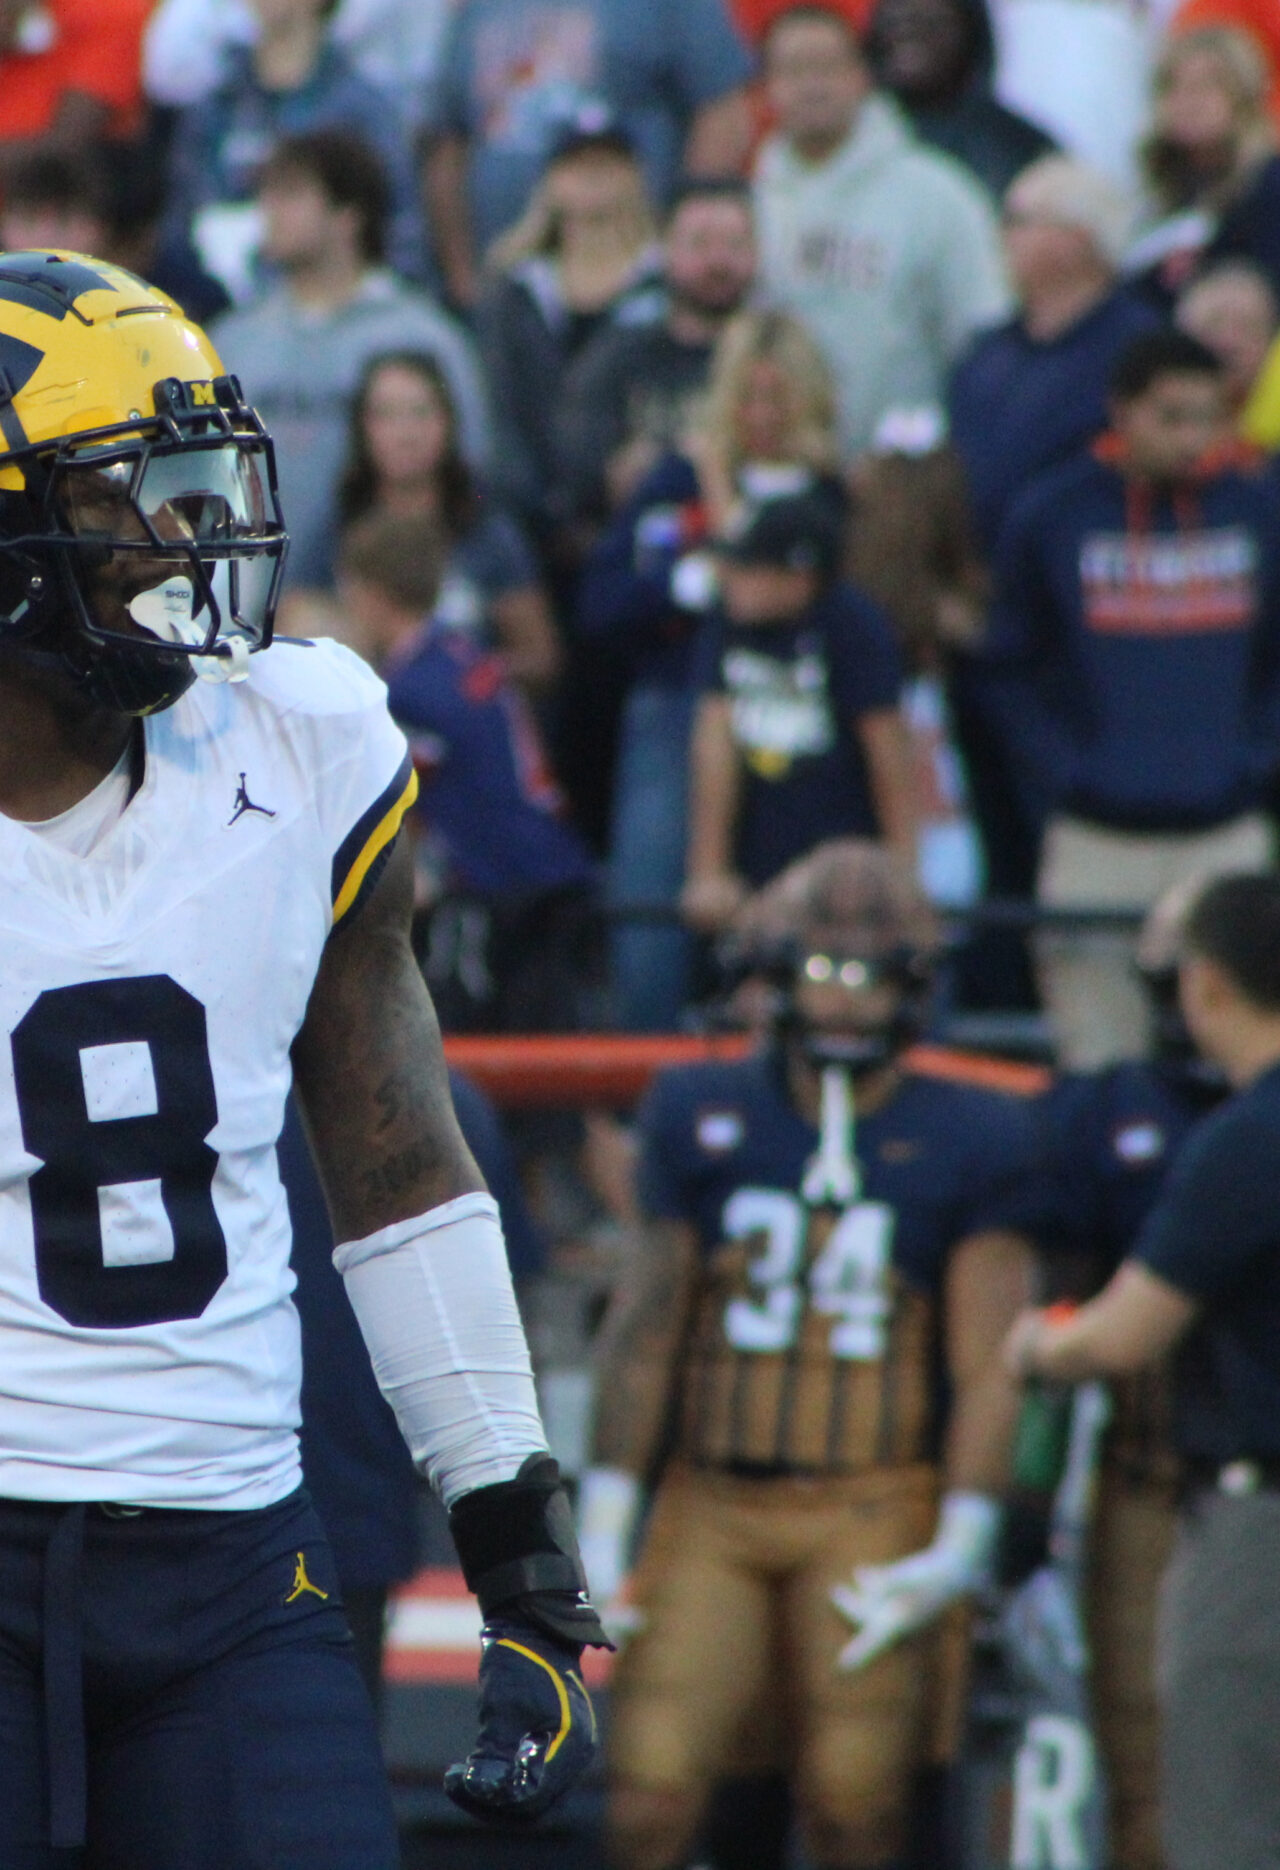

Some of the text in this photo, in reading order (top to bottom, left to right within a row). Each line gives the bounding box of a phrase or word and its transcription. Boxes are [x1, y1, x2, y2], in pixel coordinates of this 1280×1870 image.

[190, 383, 216, 405] M
[10, 973, 229, 1329] 8
[724, 1189, 890, 1358] 34
